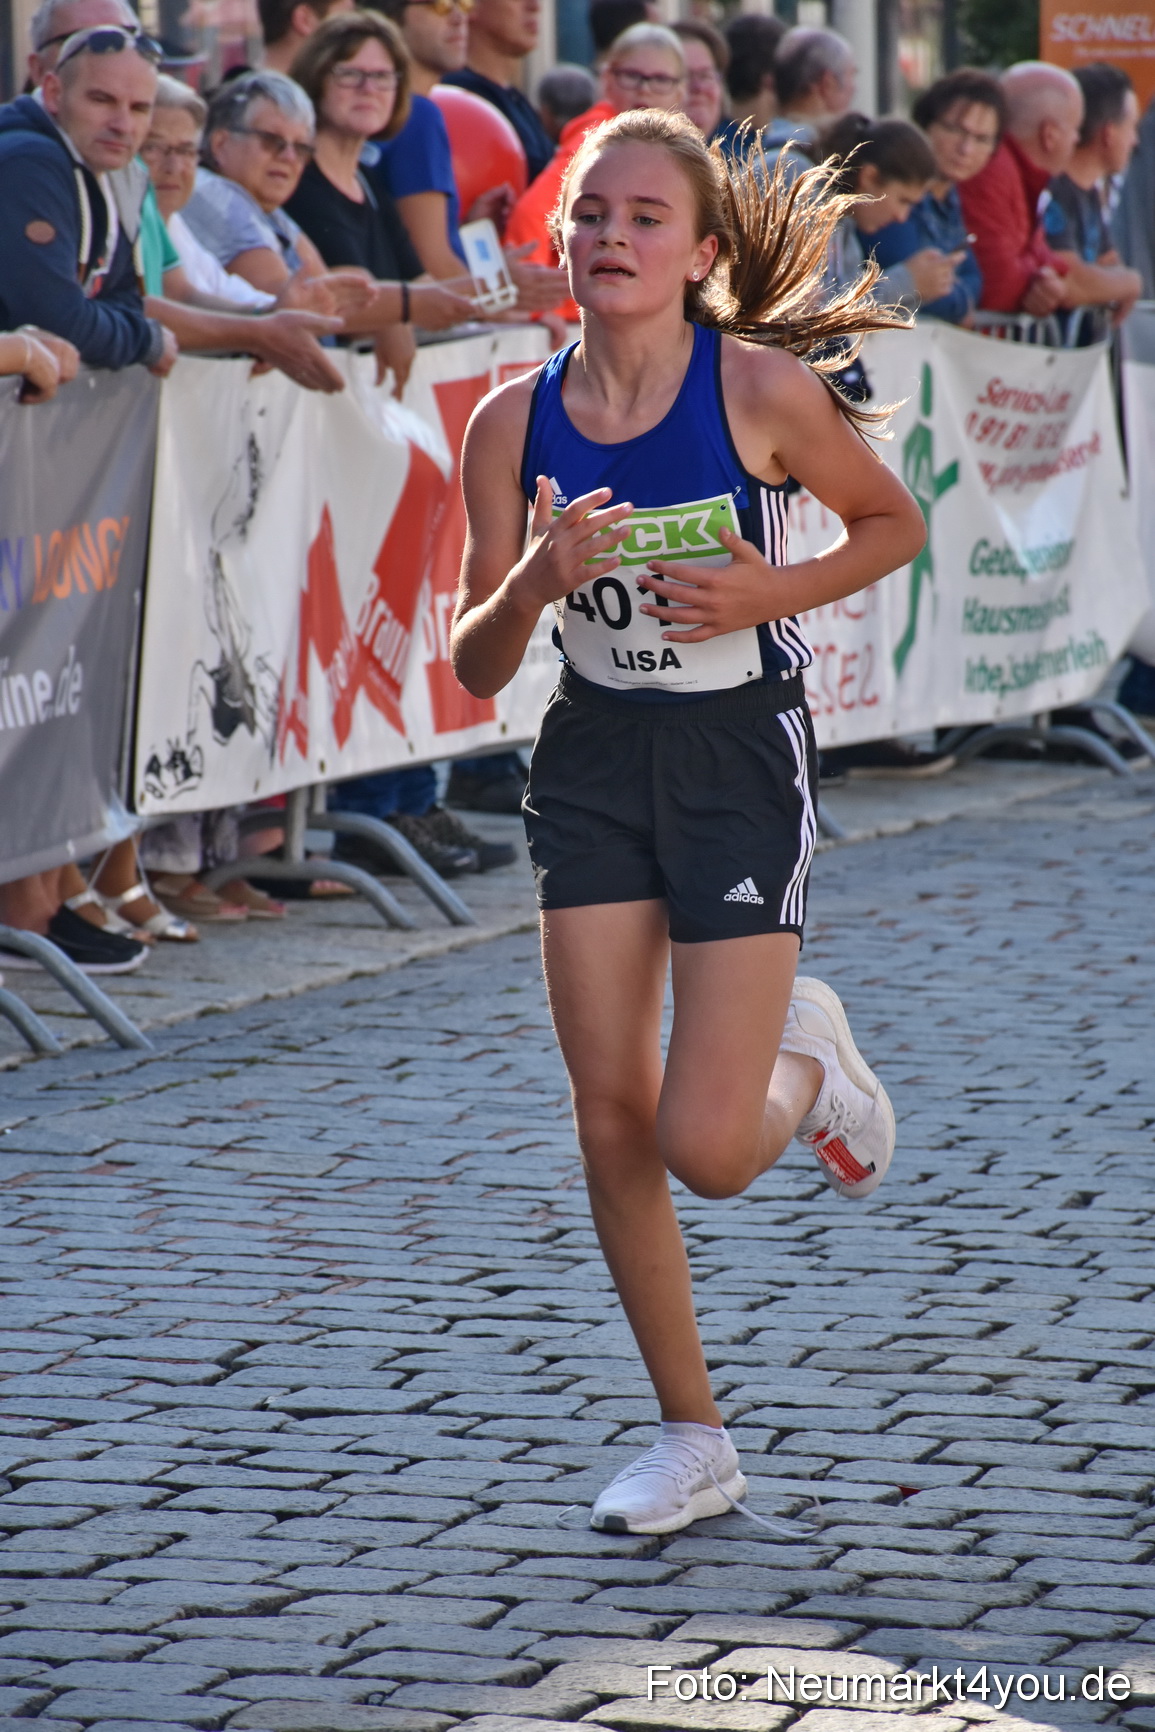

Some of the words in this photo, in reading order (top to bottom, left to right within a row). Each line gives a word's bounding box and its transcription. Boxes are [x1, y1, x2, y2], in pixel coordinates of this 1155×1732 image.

[611, 647, 682, 672] LISA
[0, 645, 82, 731] ine.de
[724, 892, 764, 904] adidas
